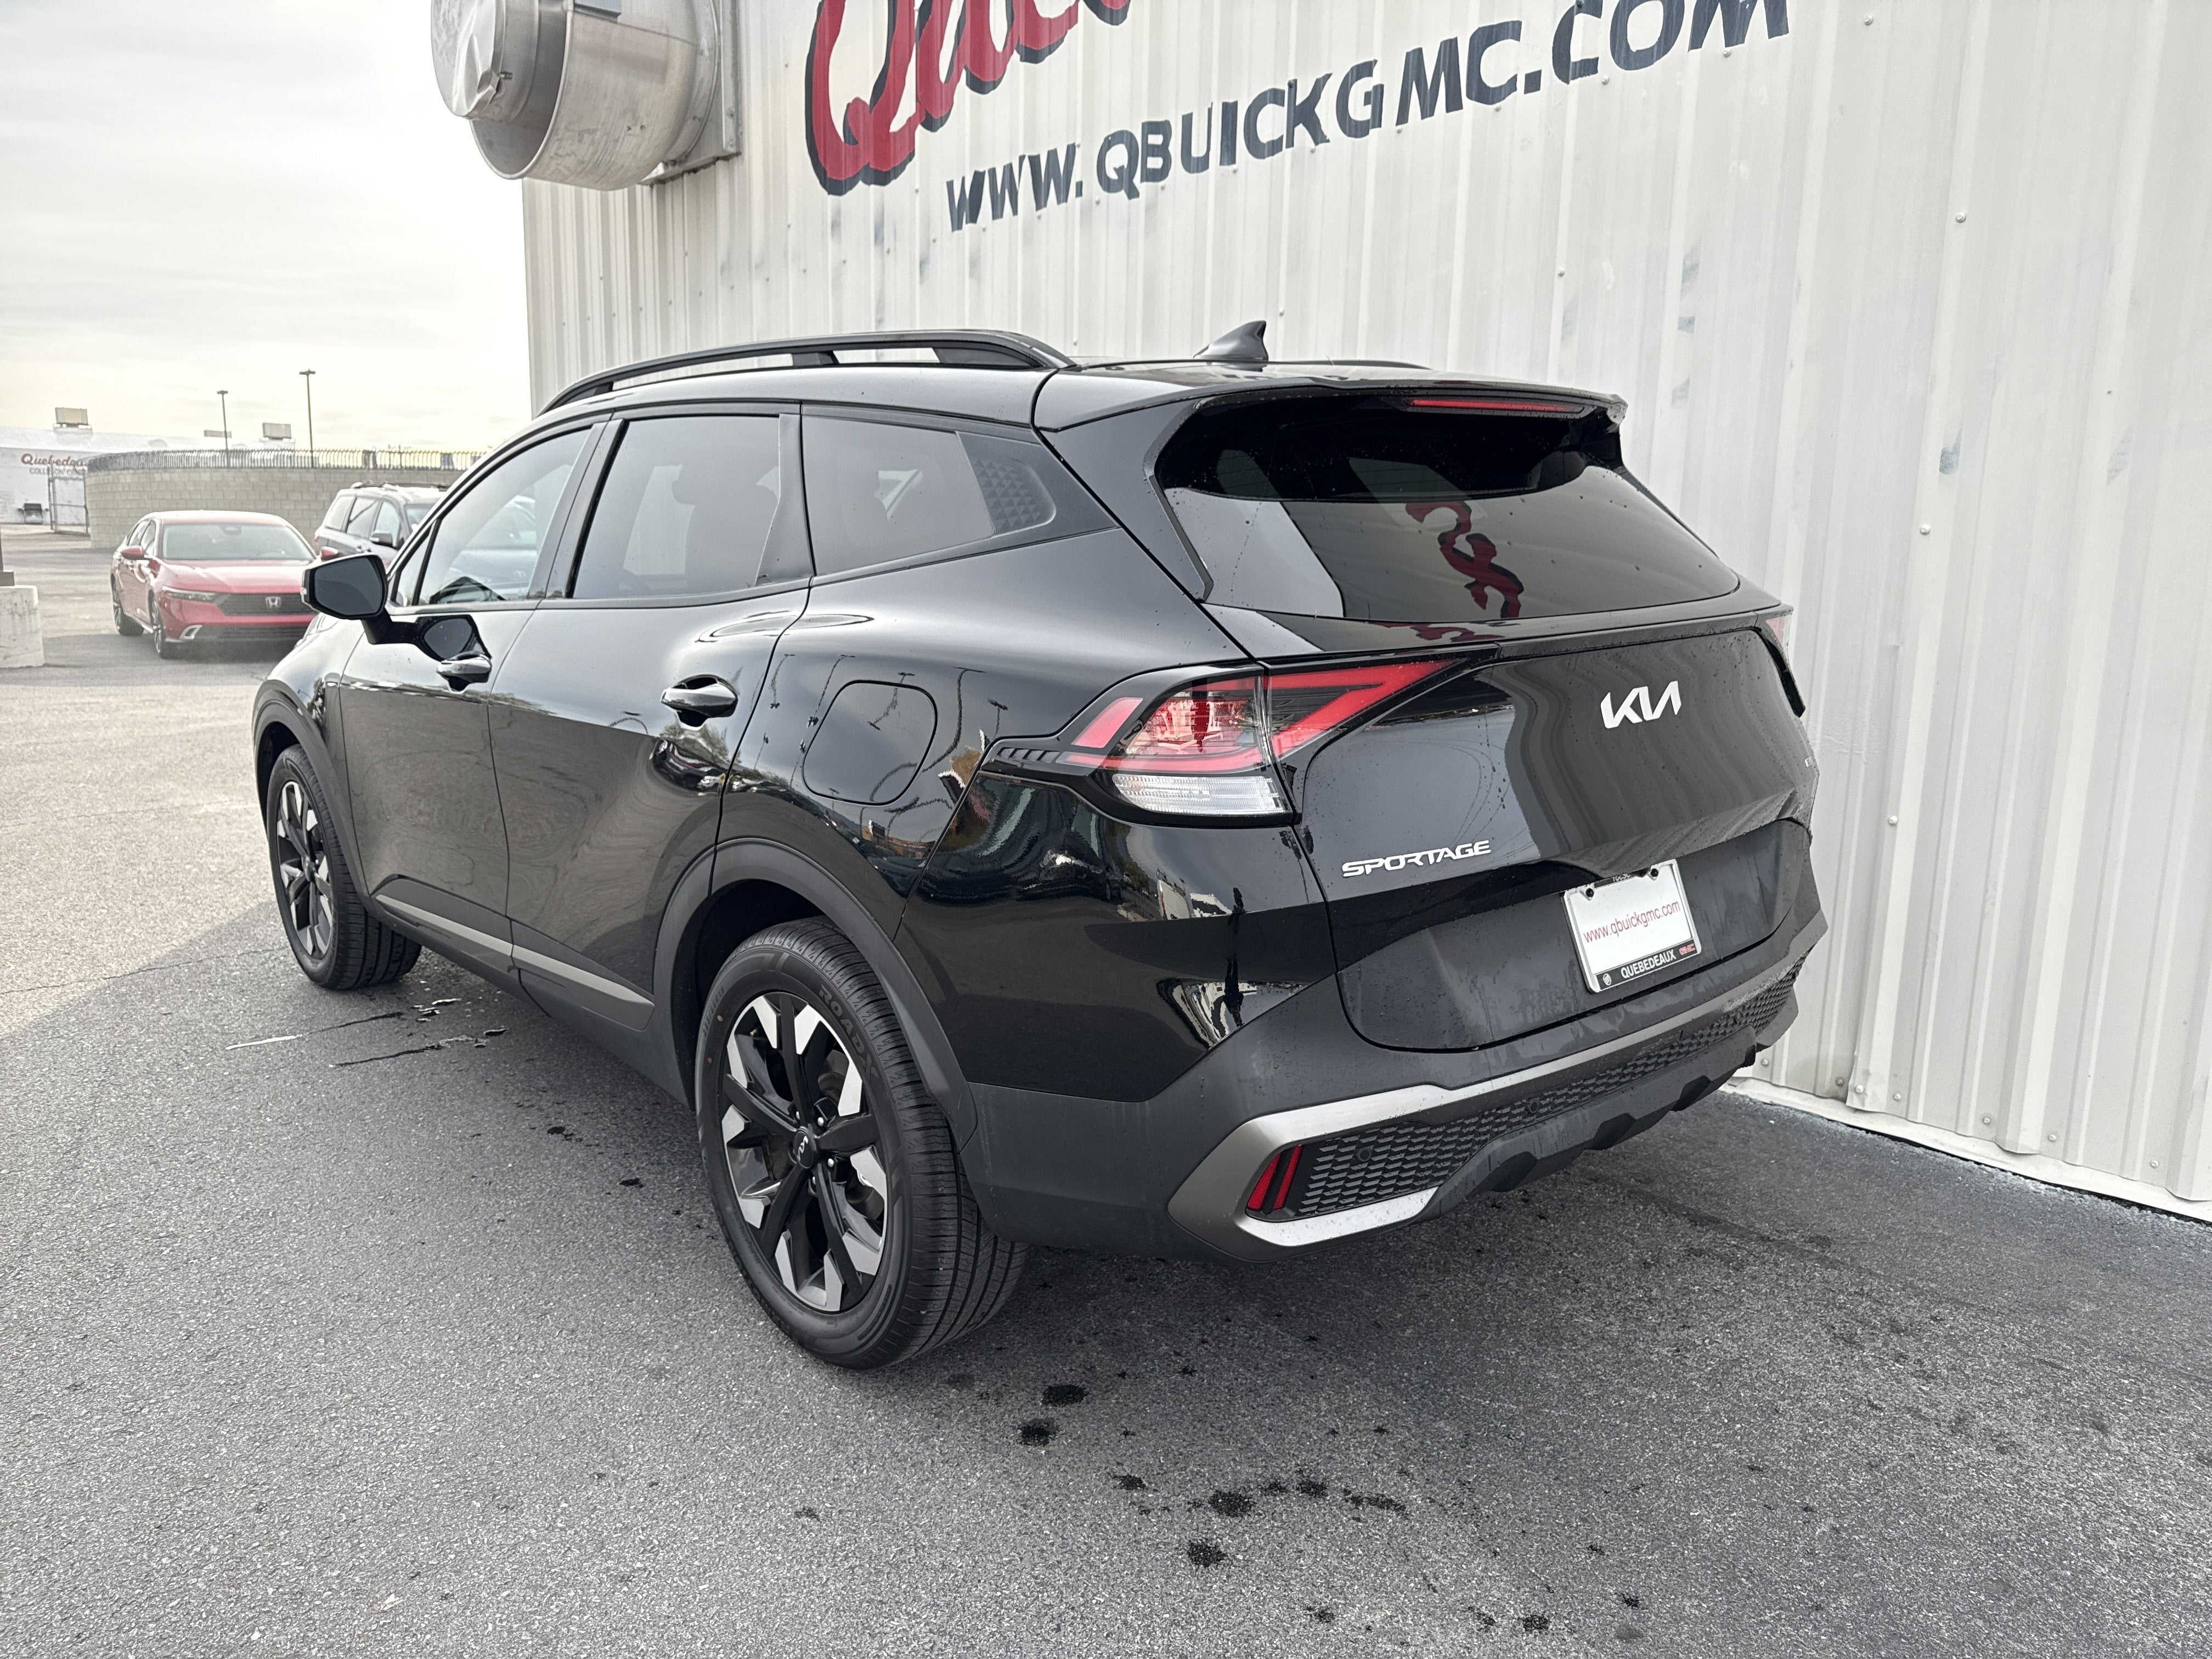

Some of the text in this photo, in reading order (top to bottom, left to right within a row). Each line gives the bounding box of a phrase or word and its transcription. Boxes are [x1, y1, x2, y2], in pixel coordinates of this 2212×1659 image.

[1600, 680, 1681, 729] KIA
[1342, 840, 1491, 877] SPORTAGE
[1583, 900, 1680, 943] www.qbuickgmc.com
[1621, 944, 1696, 979] QUEBEDEAUX GMC
[819, 984, 880, 1080] ROADX
